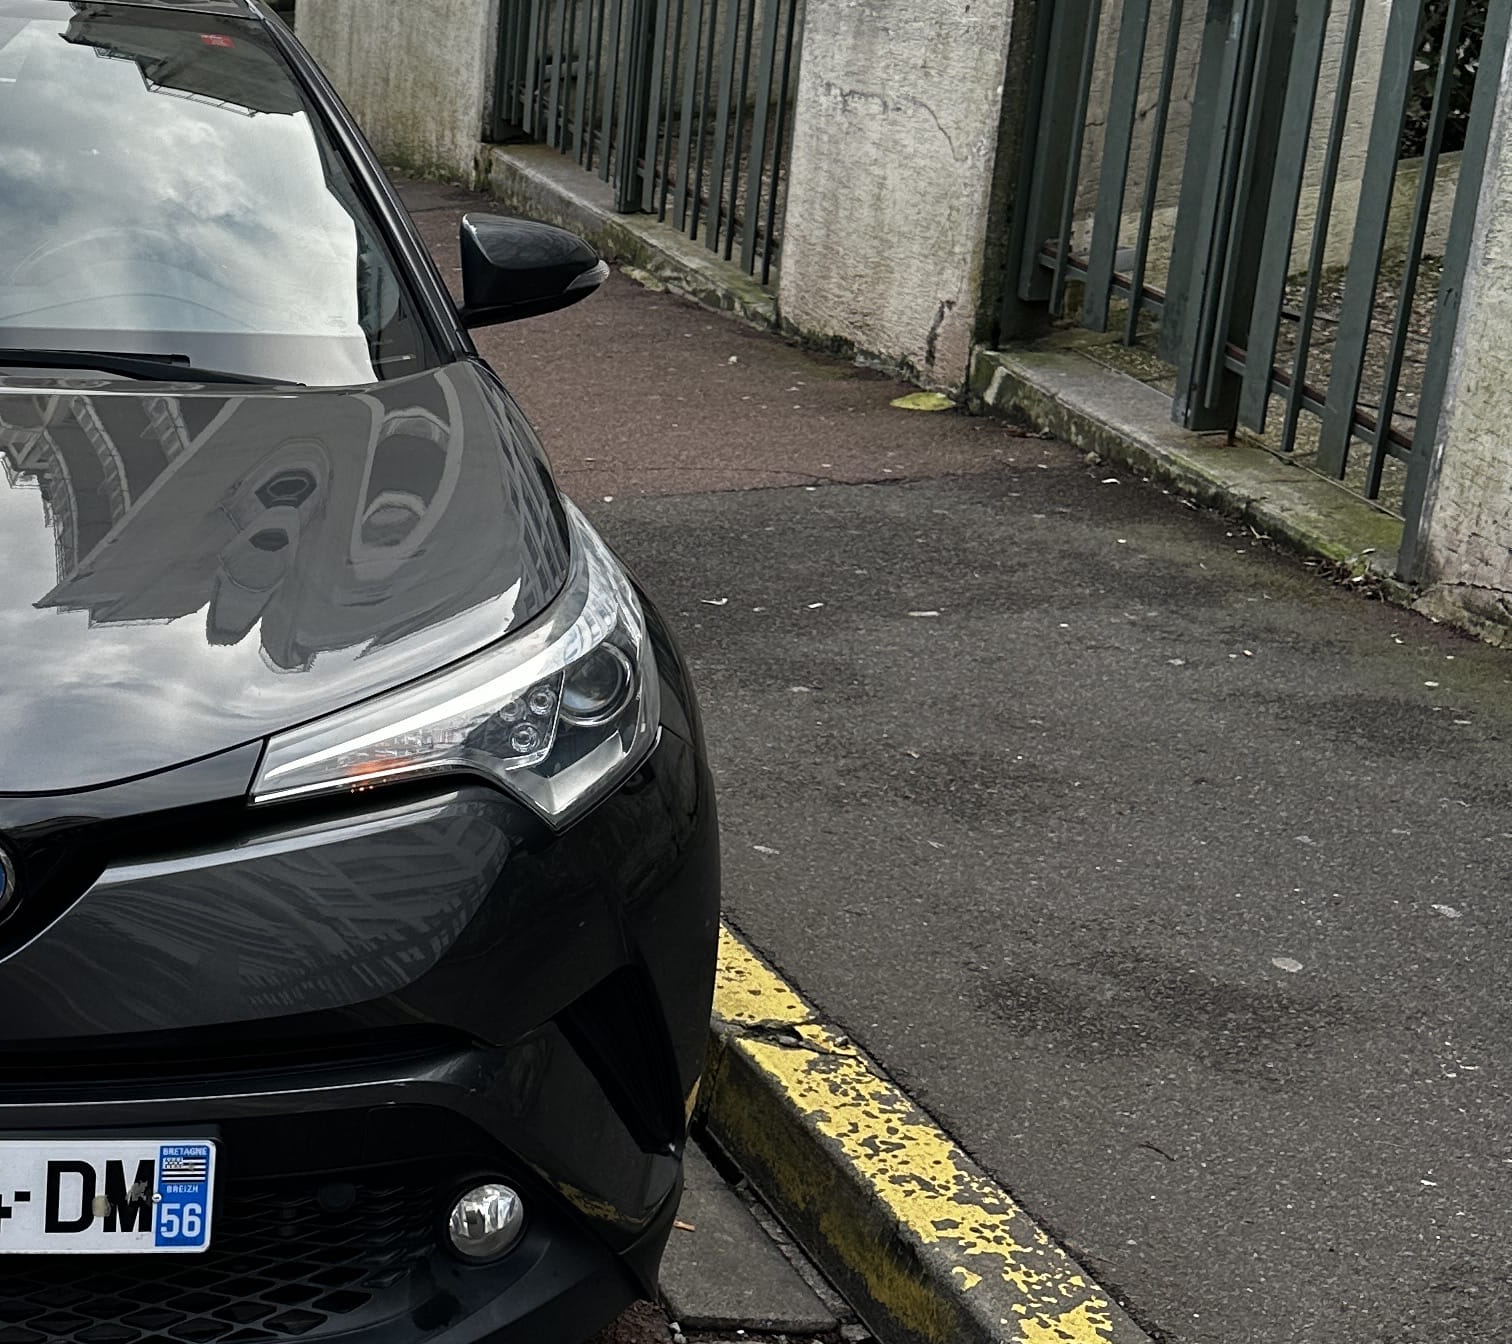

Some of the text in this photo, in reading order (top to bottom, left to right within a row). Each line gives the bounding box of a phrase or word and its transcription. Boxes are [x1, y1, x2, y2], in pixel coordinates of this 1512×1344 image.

[162, 1146, 208, 1156] BRETAGNE
[166, 1185, 199, 1193] BREIZH
[160, 1202, 202, 1238] 56
